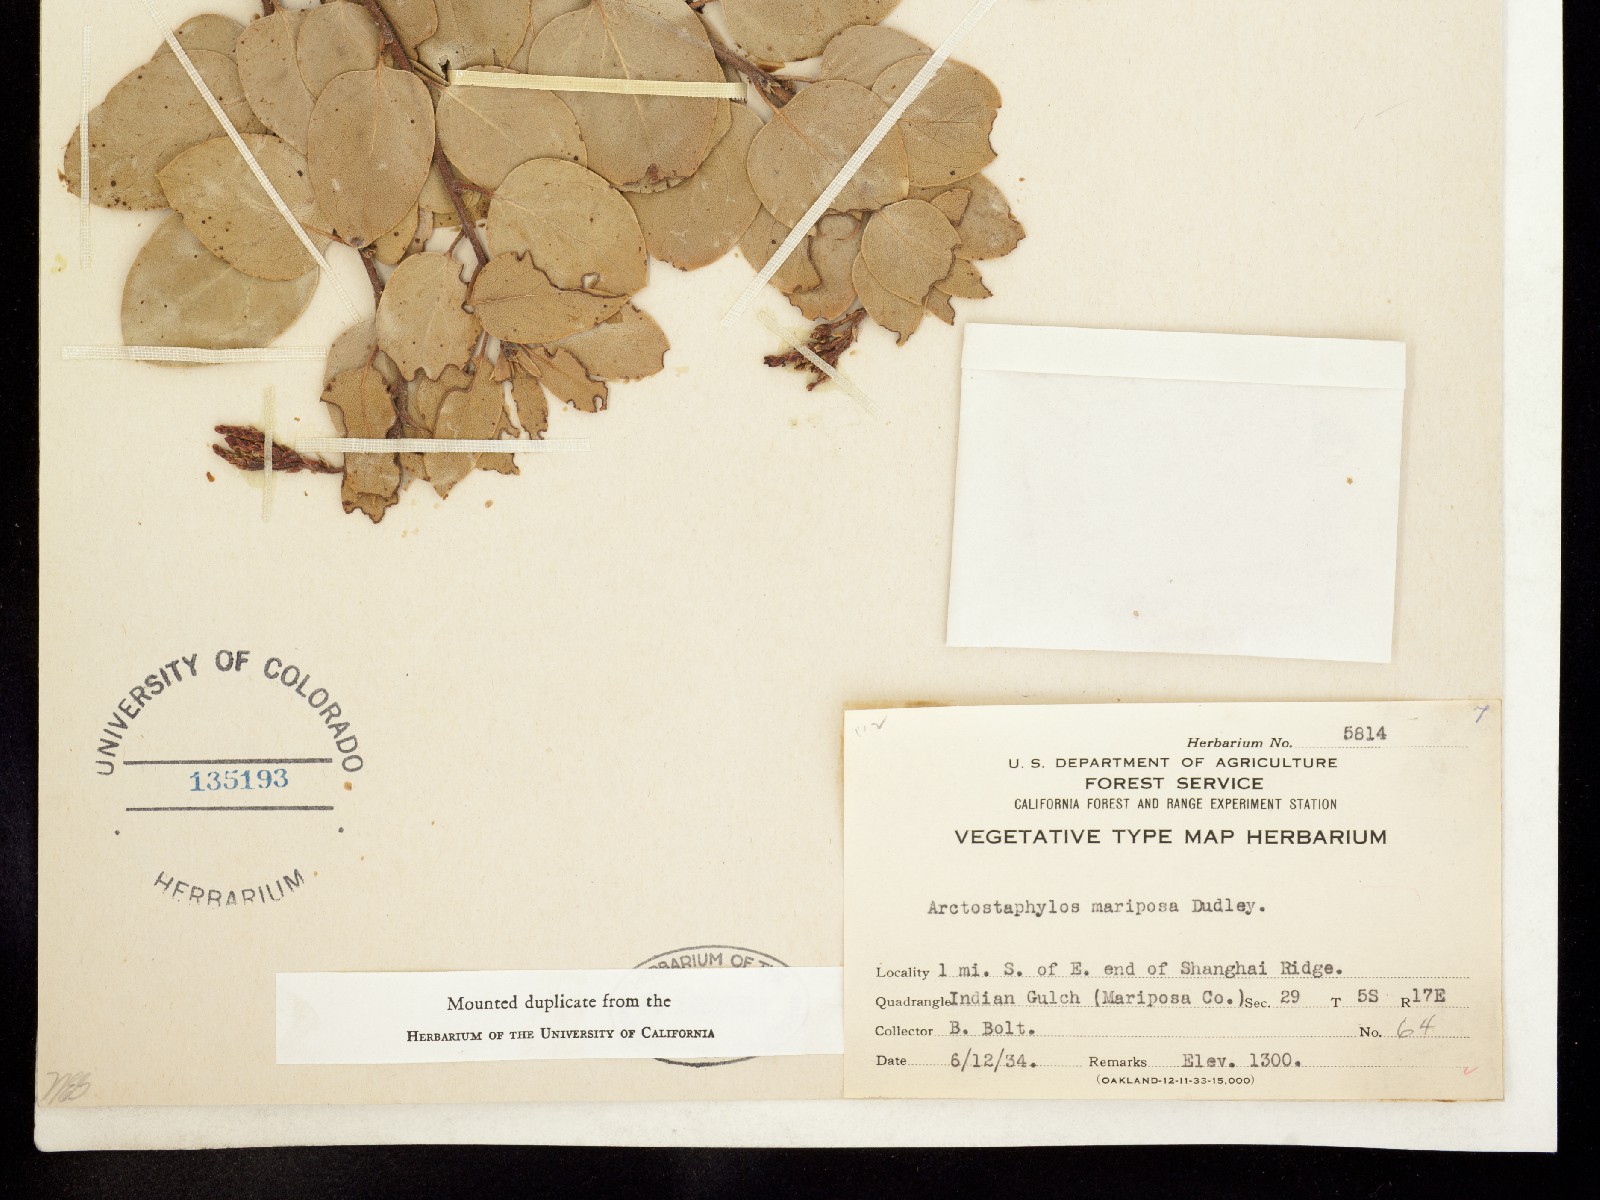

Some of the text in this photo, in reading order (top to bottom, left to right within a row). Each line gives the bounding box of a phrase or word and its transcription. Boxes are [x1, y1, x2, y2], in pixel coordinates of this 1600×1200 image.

[95, 649, 364, 776] UNIVERSITY OF COLORADO
[1188, 726, 1387, 748] Herbarium No. 5814
[1009, 758, 1337, 768] U. S. DEPARTMENT OF AGRICULTURE
[189, 768, 289, 792] 135193
[1086, 777, 1263, 789] FOREST SERVICE
[1015, 798, 1336, 809] CALIFORNIA FOREST AND RANGE EXPERIMENT STATION
[955, 829, 1386, 844] VEGETATIVE TYPE MAP HERBARIUM
[928, 898, 1265, 917] Arctostaphylos mariposa Dudley.
[876, 963, 929, 980] Locality
[959, 963, 989, 977] mi.
[1004, 962, 1023, 977] S.
[1037, 962, 1060, 977] of
[1071, 962, 1089, 977] E.
[1102, 962, 1137, 978] end
[1146, 962, 1170, 978] of
[1179, 961, 1268, 978] Shanghai
[1278, 961, 1345, 978] Ridge.
[447, 994, 671, 1012] Mounted duplicate from the
[876, 988, 1445, 1009] Quadrangle Indian Gulch (Mariposa Co.) Sec. 29 T 5S R 17E
[875, 1021, 1038, 1036] Collector B. Bolt.
[1360, 1027, 1382, 1037] No.
[1395, 1013, 1436, 1040] 64
[876, 1048, 1041, 1072] Date 6/12/34.
[1089, 1053, 1303, 1068] Remarks Elev. 1300.
